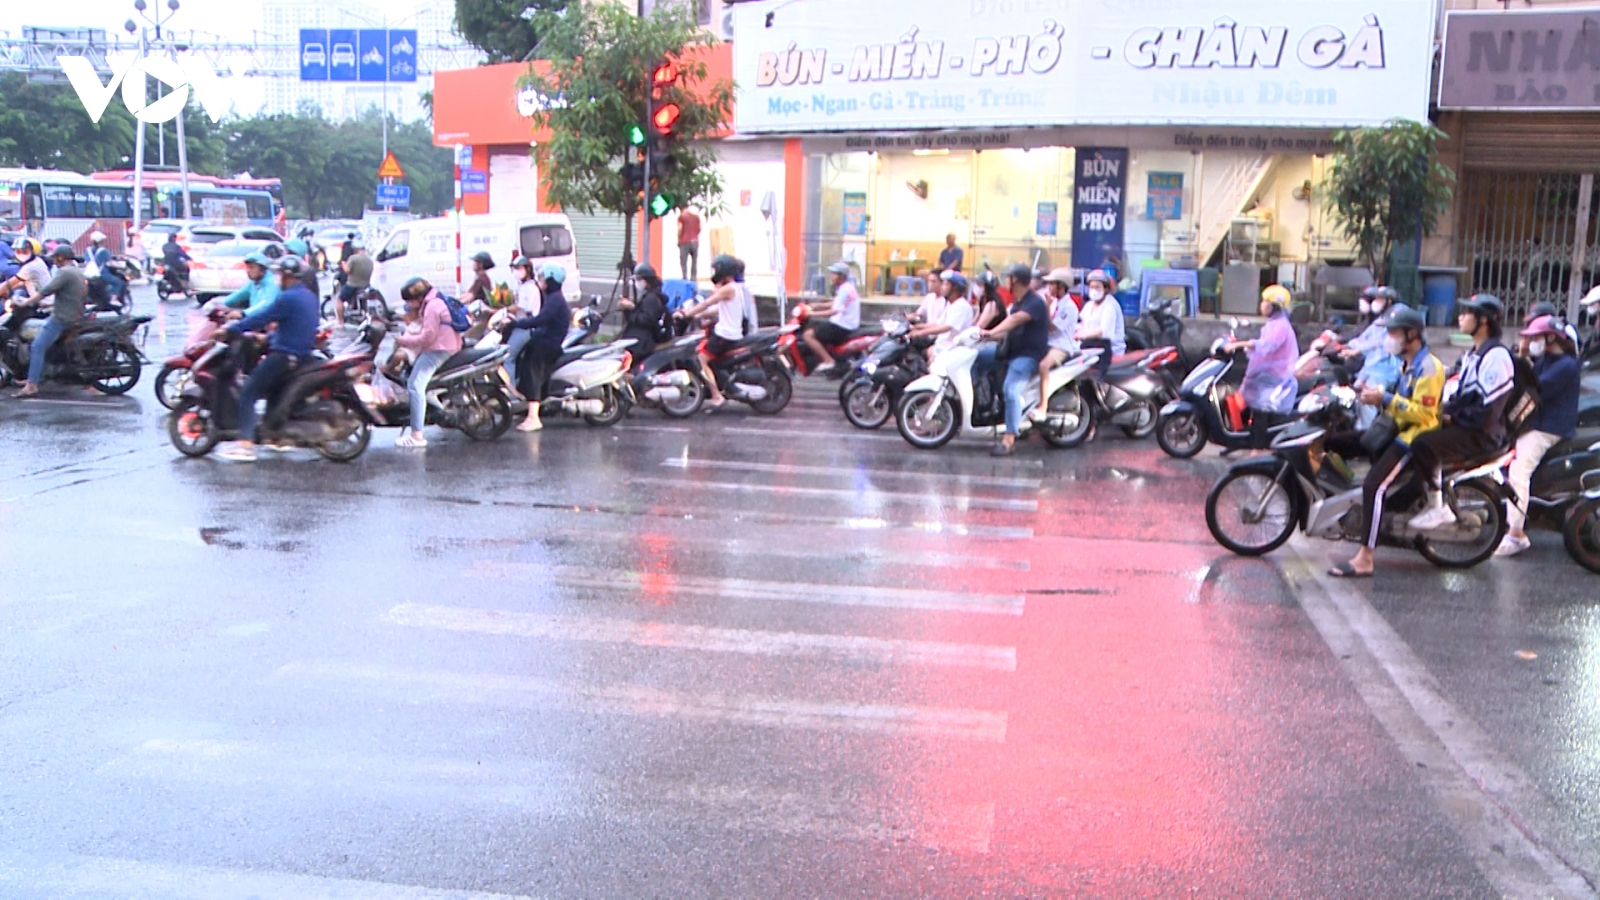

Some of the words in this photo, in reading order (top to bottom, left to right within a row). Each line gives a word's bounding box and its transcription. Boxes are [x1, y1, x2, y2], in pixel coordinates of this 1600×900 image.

[756, 40, 828, 88] BÚN
[848, 24, 945, 82] MIẾN
[970, 18, 1066, 77] PHỞ
[1123, 14, 1289, 70] CHÂN
[1296, 12, 1387, 70] GÀ
[767, 95, 802, 116] Mọc
[811, 93, 858, 116] Ngan
[1152, 80, 1245, 109] Nhậu
[897, 135, 911, 147] tin
[936, 133, 957, 146] cho
[960, 133, 982, 147] mọi
[1174, 131, 1203, 146] Điểm
[1231, 134, 1246, 147] tin
[1249, 134, 1269, 150] cậy
[1271, 134, 1293, 148] cho
[1296, 135, 1317, 150] mọi
[1077, 178, 1121, 205] MIẾN
[1080, 207, 1118, 231] PHỞ
